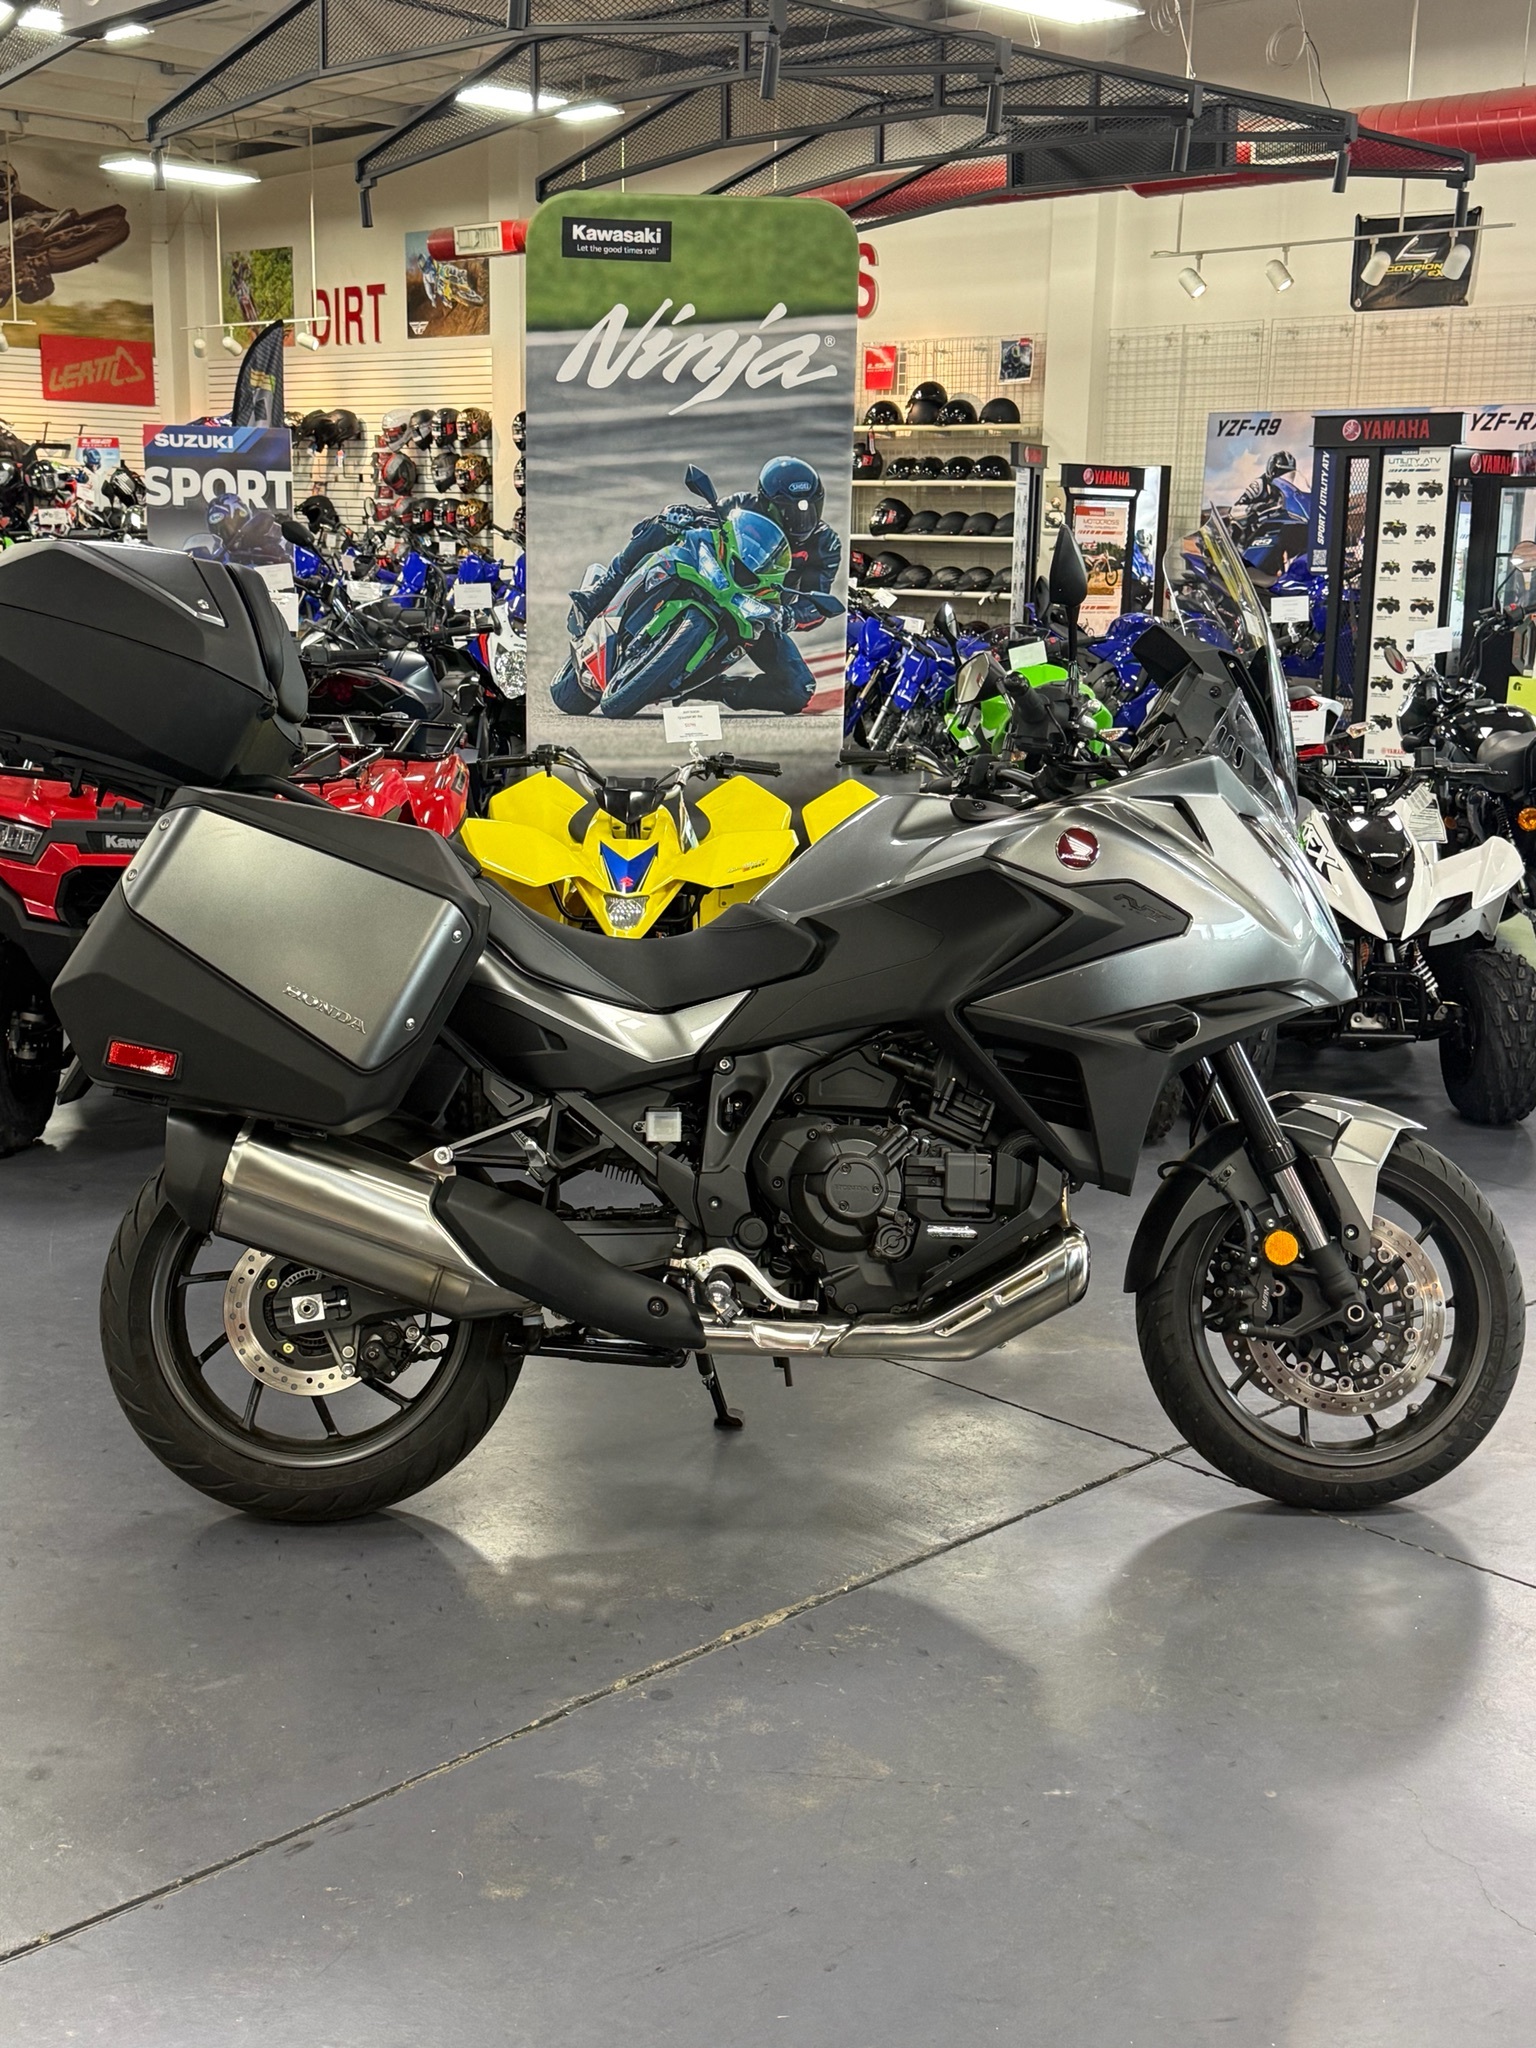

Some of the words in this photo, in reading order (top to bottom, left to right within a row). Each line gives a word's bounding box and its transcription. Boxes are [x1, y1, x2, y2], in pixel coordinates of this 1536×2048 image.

[572, 224, 662, 244] Kawasaki
[576, 244, 589, 252] Let
[590, 245, 602, 253] the
[603, 246, 623, 255] good
[312, 284, 387, 346] DIRT
[1217, 418, 1282, 437] YZF-R9
[1362, 419, 1430, 440] YAMAHA
[154, 433, 233, 449] SUZUKI
[1322, 451, 1330, 471] ATV
[1388, 457, 1421, 465] UTILITY
[1094, 469, 1130, 486] YAMAHA
[145, 466, 293, 510] SPORT
[1319, 470, 1329, 506] UTILITY
[1316, 512, 1327, 546] SPORT
[105, 834, 144, 849] Kaw
[282, 982, 366, 1035] HONDA
